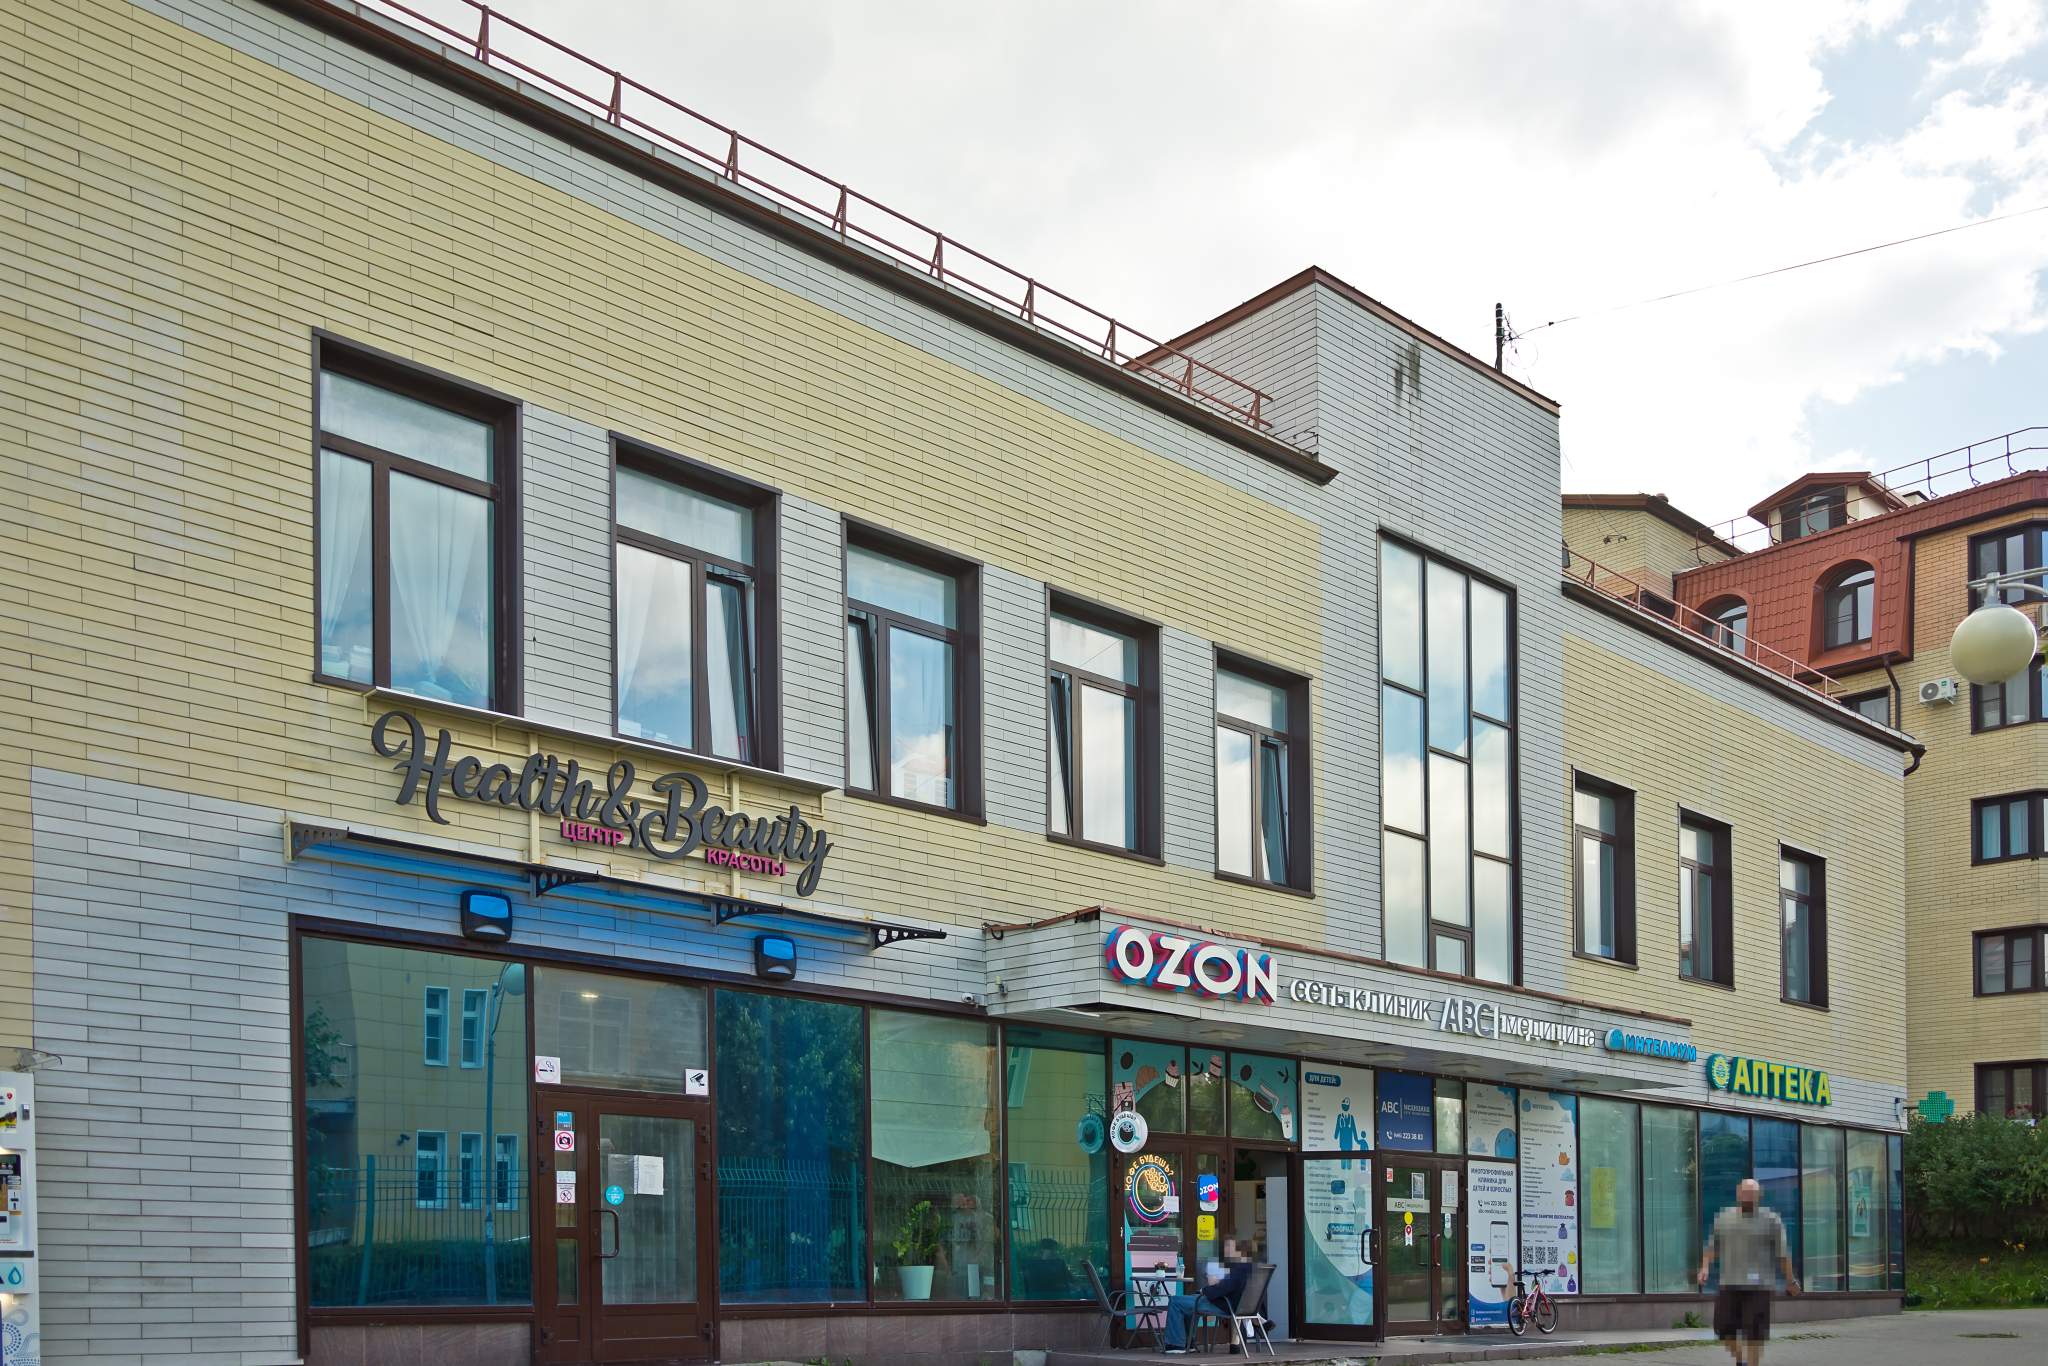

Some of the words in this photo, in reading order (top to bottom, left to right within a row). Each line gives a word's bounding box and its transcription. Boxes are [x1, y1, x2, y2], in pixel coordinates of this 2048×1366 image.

[560, 822, 625, 847] ЦЕНТР
[705, 849, 787, 876] КРАСОТЫ
[1104, 925, 1278, 1005] OZON
[1501, 1014, 1596, 1047] медицина
[1625, 1033, 1697, 1063] ИНТЕЛИУМ
[1730, 1057, 1833, 1106] АПТЕКА
[1124, 1161, 1140, 1191] КОФЕ
[1139, 1154, 1175, 1177] БУДЕШЬ?
